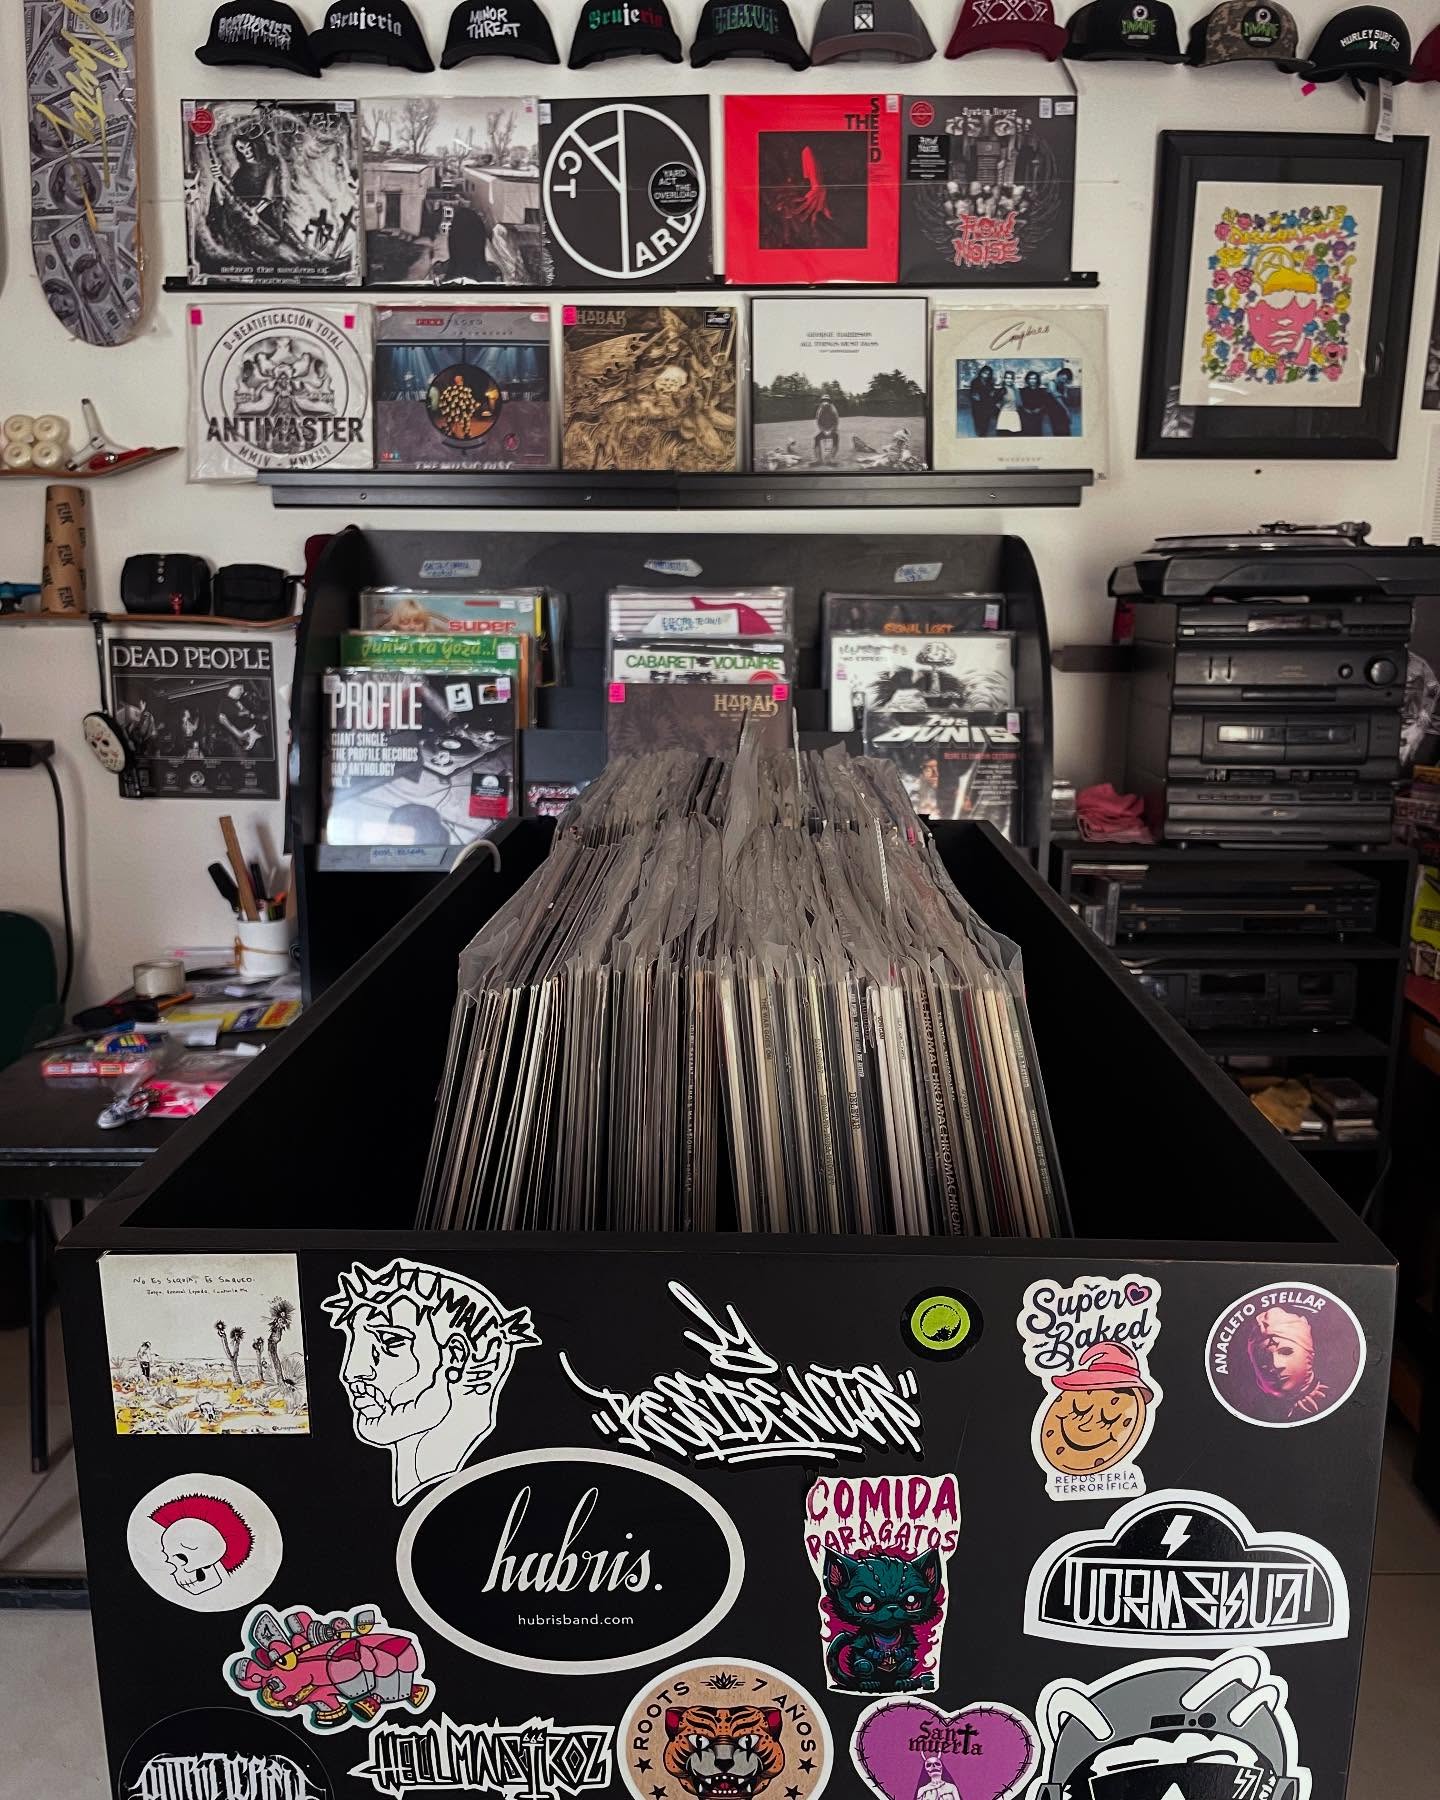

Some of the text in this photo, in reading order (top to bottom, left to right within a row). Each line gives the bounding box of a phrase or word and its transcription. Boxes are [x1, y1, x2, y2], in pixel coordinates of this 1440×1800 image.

[470, 6, 508, 23] MINOR
[466, 22, 521, 39] THREAT
[1339, 29, 1374, 48] HURLEY
[1374, 29, 1393, 42] SURF
[658, 177, 677, 186] ACT
[675, 183, 692, 192] THE
[653, 190, 698, 200] OVERLOAD
[315, 320, 345, 351] TOTAL
[206, 416, 364, 443] ANTIMASTER
[111, 645, 271, 670] DEAD PEOPLE
[625, 655, 781, 671] CABARET VOLTAIRE
[331, 681, 423, 730] PROFILE
[331, 731, 389, 747] GIANT SINGLE:
[331, 747, 418, 763] THE PROFILE RECORDS
[349, 762, 396, 777] ANTHOLOGY
[761, 997, 769, 1012] THE
[763, 1029, 771, 1048] GOES
[132, 1276, 146, 1285] No
[1026, 1283, 1125, 1335] Super
[1033, 1309, 1153, 1371] Baked
[1214, 1291, 1327, 1375] ANACLETO STELLAR
[1055, 1471, 1136, 1485] REPOSTERÍA
[1054, 1480, 1139, 1494] TERRORÍFICA
[807, 1476, 958, 1524] COMIDA
[481, 1485, 663, 1593] hubris.
[517, 1613, 635, 1626] hubrisband.com
[751, 1677, 769, 1693] 7
[633, 1681, 691, 1751] ROOTS
[772, 1694, 818, 1752] AÑOS
